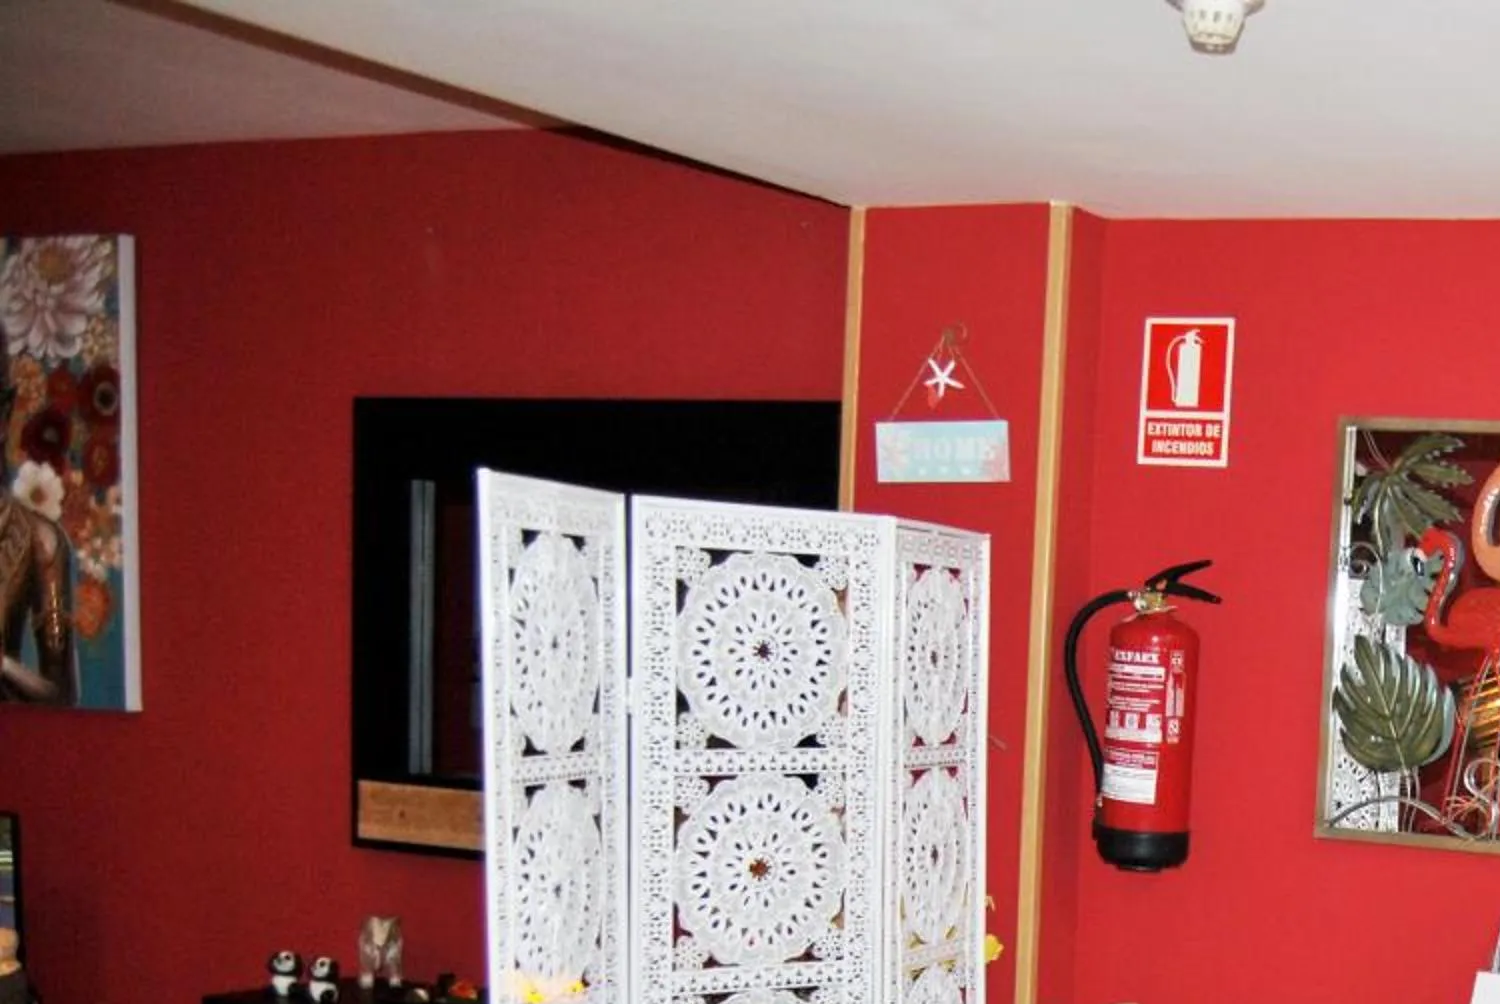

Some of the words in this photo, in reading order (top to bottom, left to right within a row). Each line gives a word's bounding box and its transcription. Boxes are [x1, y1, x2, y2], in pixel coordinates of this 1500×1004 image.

[1147, 421, 1203, 437] EXTINTOR
[1205, 423, 1222, 438] DE
[1151, 439, 1214, 456] INCENDIOS
